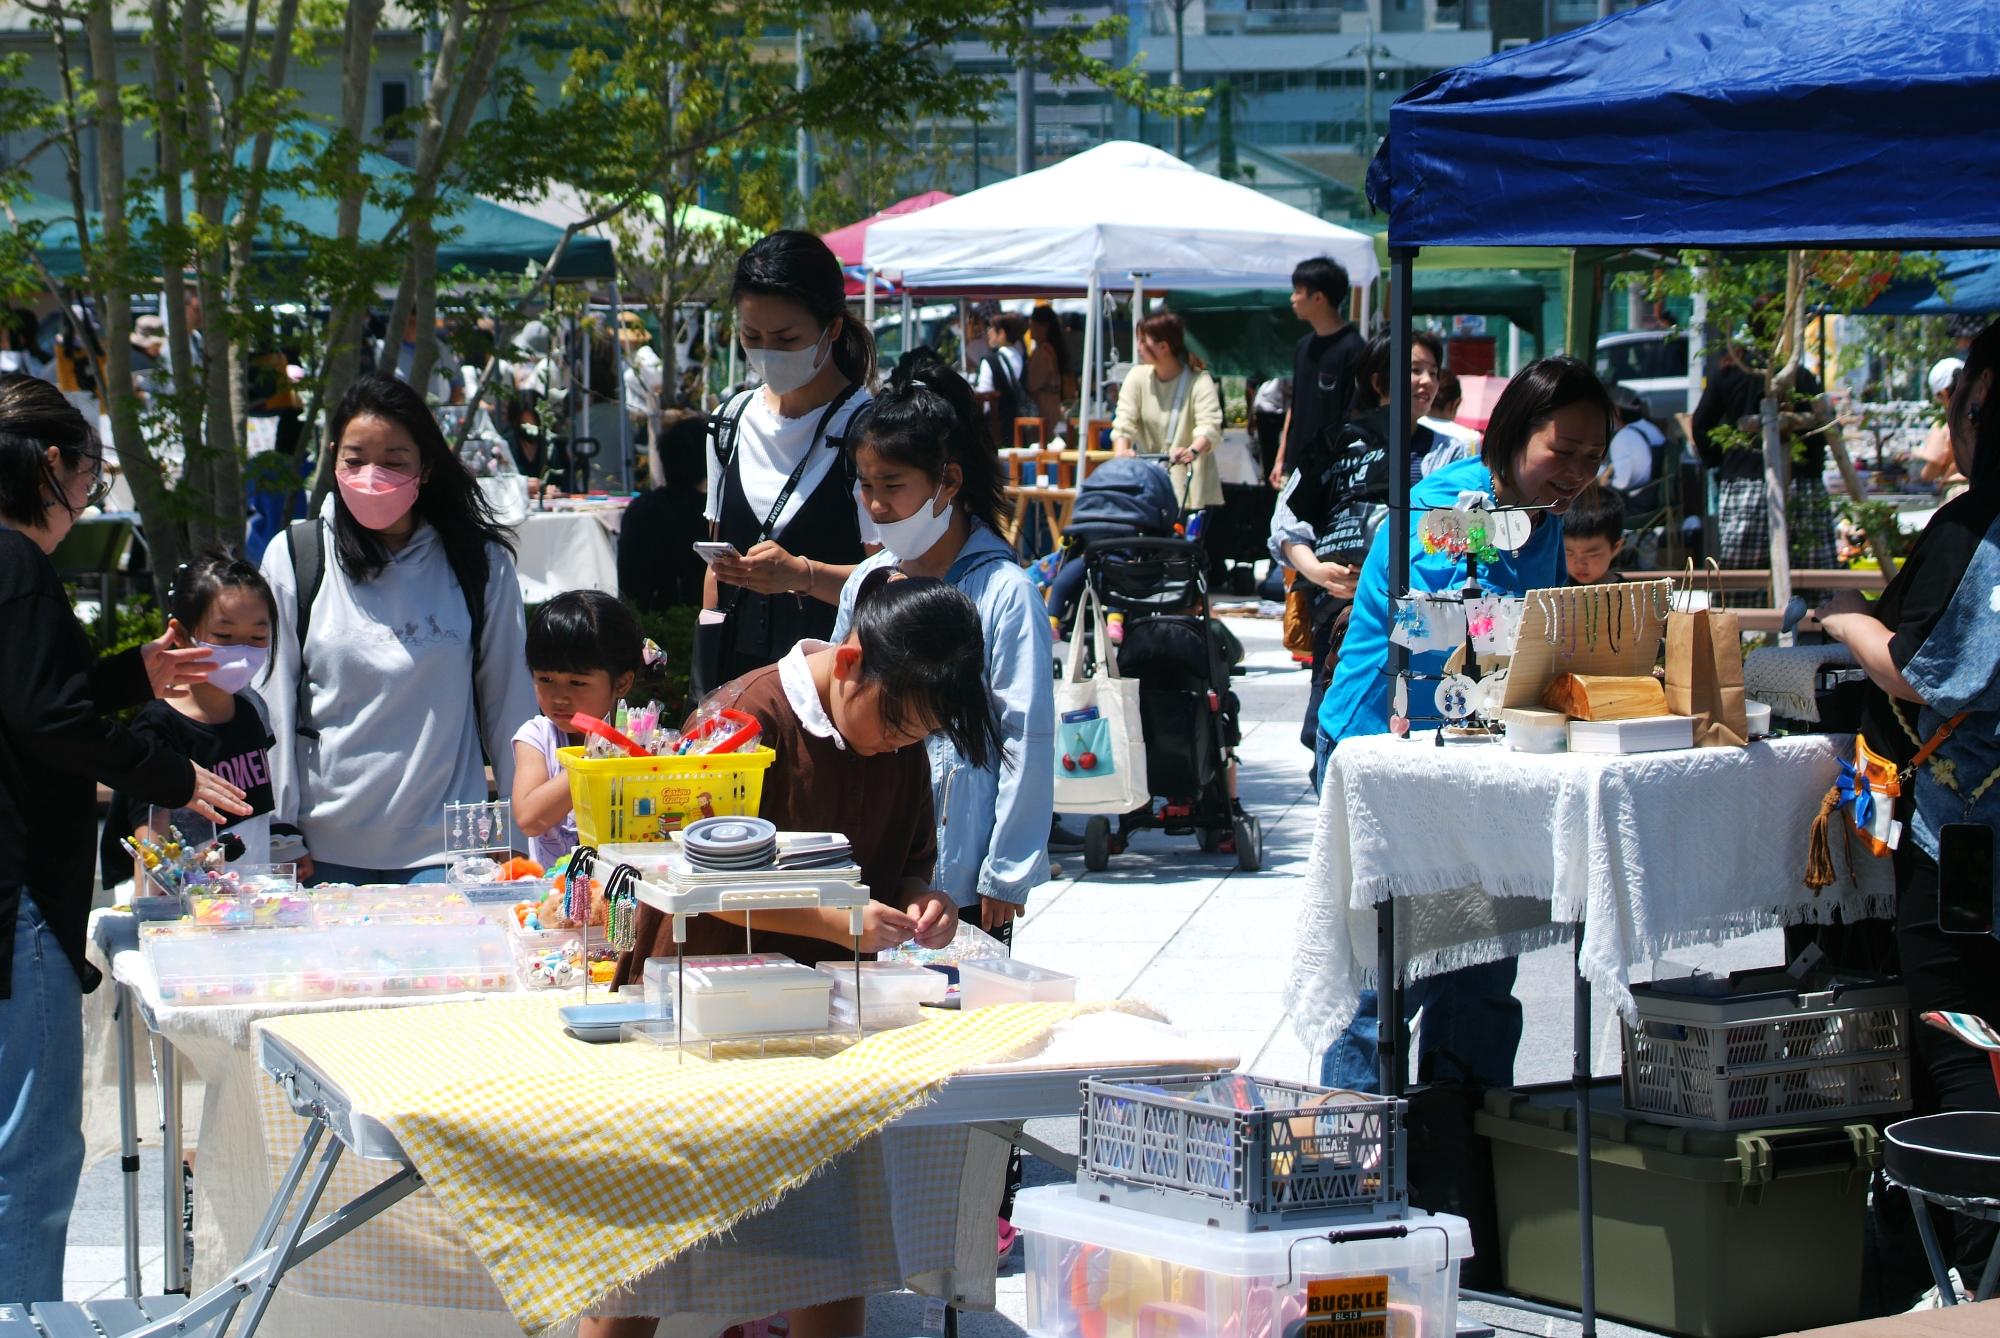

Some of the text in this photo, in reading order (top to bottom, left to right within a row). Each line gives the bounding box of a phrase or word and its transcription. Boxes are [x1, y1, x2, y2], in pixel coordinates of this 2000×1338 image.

[213, 747, 272, 790] OMEN
[1308, 1291, 1386, 1312] BUCKLE
[1335, 1311, 1358, 1320] BL-13
[1307, 1320, 1385, 1338] CONTAINER
